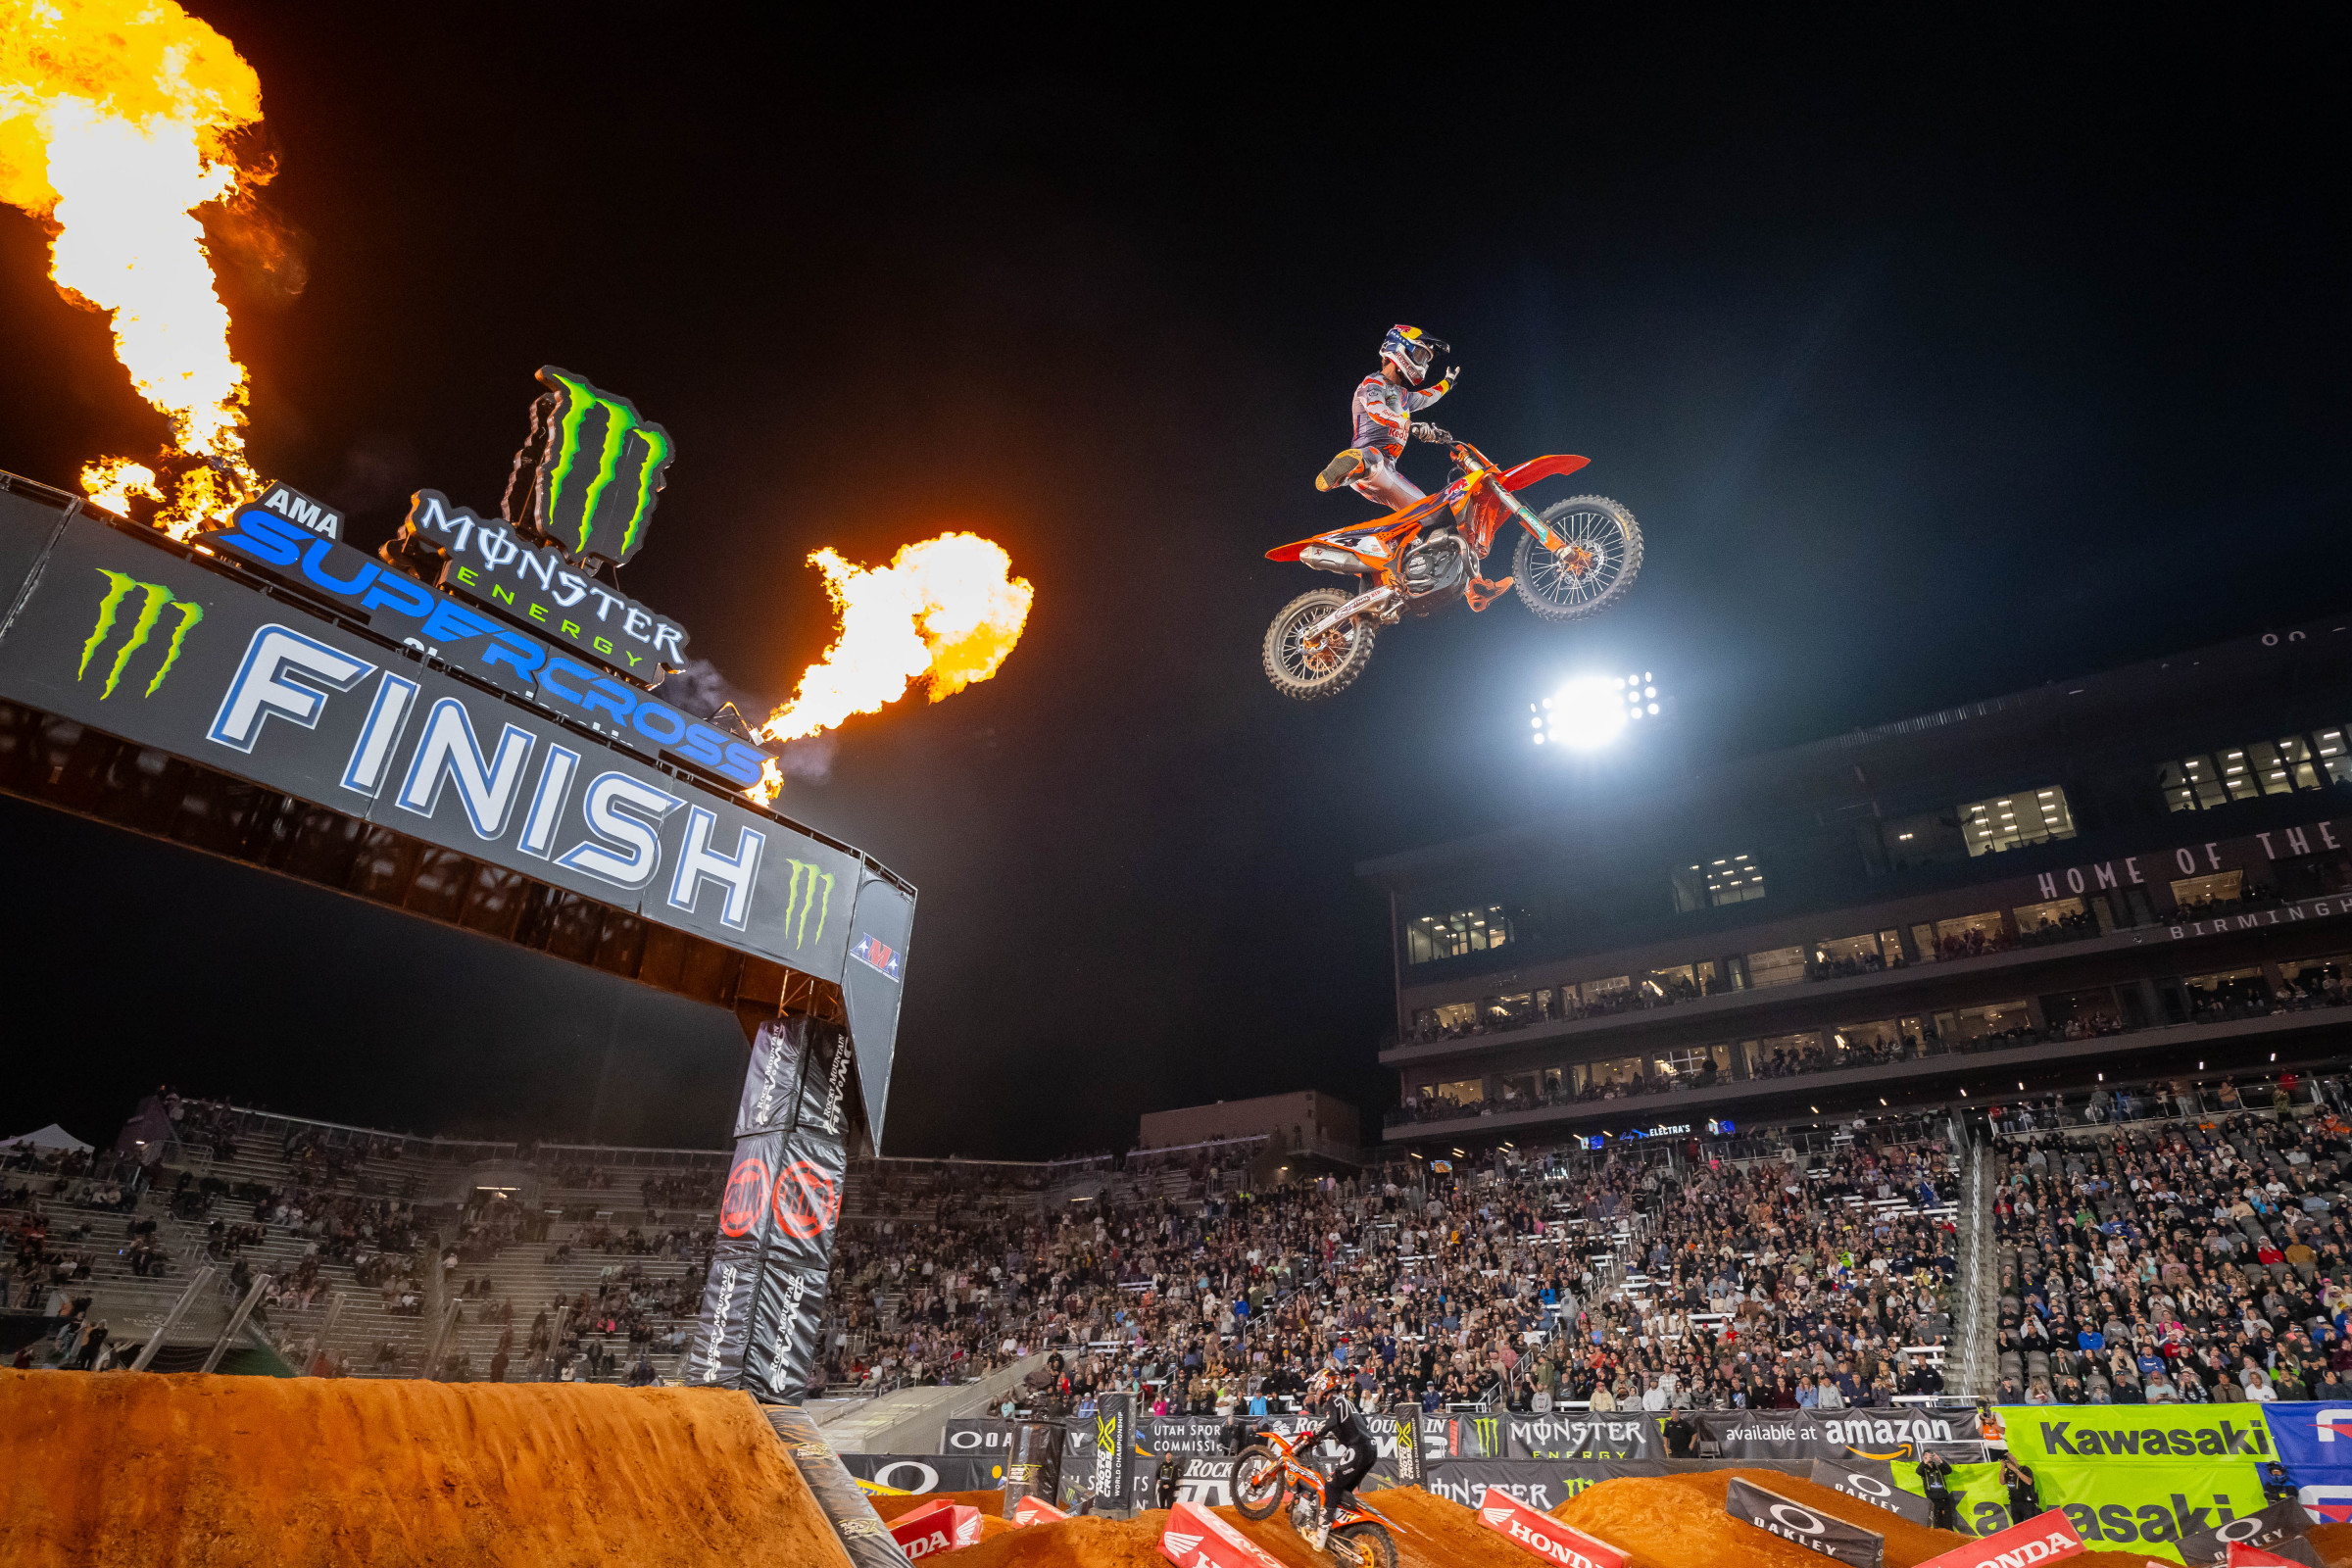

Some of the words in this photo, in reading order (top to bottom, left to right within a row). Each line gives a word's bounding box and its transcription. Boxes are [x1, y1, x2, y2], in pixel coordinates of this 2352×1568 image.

[264, 488, 338, 539] AMA
[420, 497, 689, 665] MONSTER
[457, 565, 643, 667] ENERGY
[219, 510, 770, 786] SUPERCROSS
[206, 622, 766, 931] FINISH
[2037, 857, 2144, 899] HOME
[2176, 843, 2221, 875] OF
[2256, 821, 2341, 859] THE
[849, 931, 901, 980] AMA
[764, 1025, 780, 1079] MOUNTAIN
[829, 1033, 845, 1086] MOUNTAIN
[758, 1074, 771, 1109] ROCKY
[822, 1082, 836, 1118] ROCKY
[1649, 1124, 1690, 1137] ELECTRA'S
[713, 1267, 730, 1328] MOUNTAIN
[778, 1274, 796, 1337] MOUNTAIN
[707, 1329, 717, 1365] ROCKY
[769, 1337, 783, 1372] ROCKY
[986, 1433, 1085, 1447] OAY
[1115, 1411, 1124, 1467] CHAMPIONSHIP
[1153, 1425, 1185, 1437] UTAH
[1190, 1425, 1221, 1437] SPOR
[1153, 1441, 1223, 1452] COMMISSI
[1510, 1418, 1646, 1446] MONSTER
[1726, 1424, 1796, 1441] available
[1800, 1428, 1818, 1441] at
[1826, 1419, 1953, 1445] amazon
[2039, 1420, 2272, 1456] Kawasaki
[1103, 1450, 1113, 1498] CROSS
[1430, 1477, 1553, 1510] ONSER
[1835, 1483, 1902, 1514] OAKLEY
[1948, 1490, 2236, 1544] Kaasaki
[1753, 1516, 1838, 1557] OAKLEY
